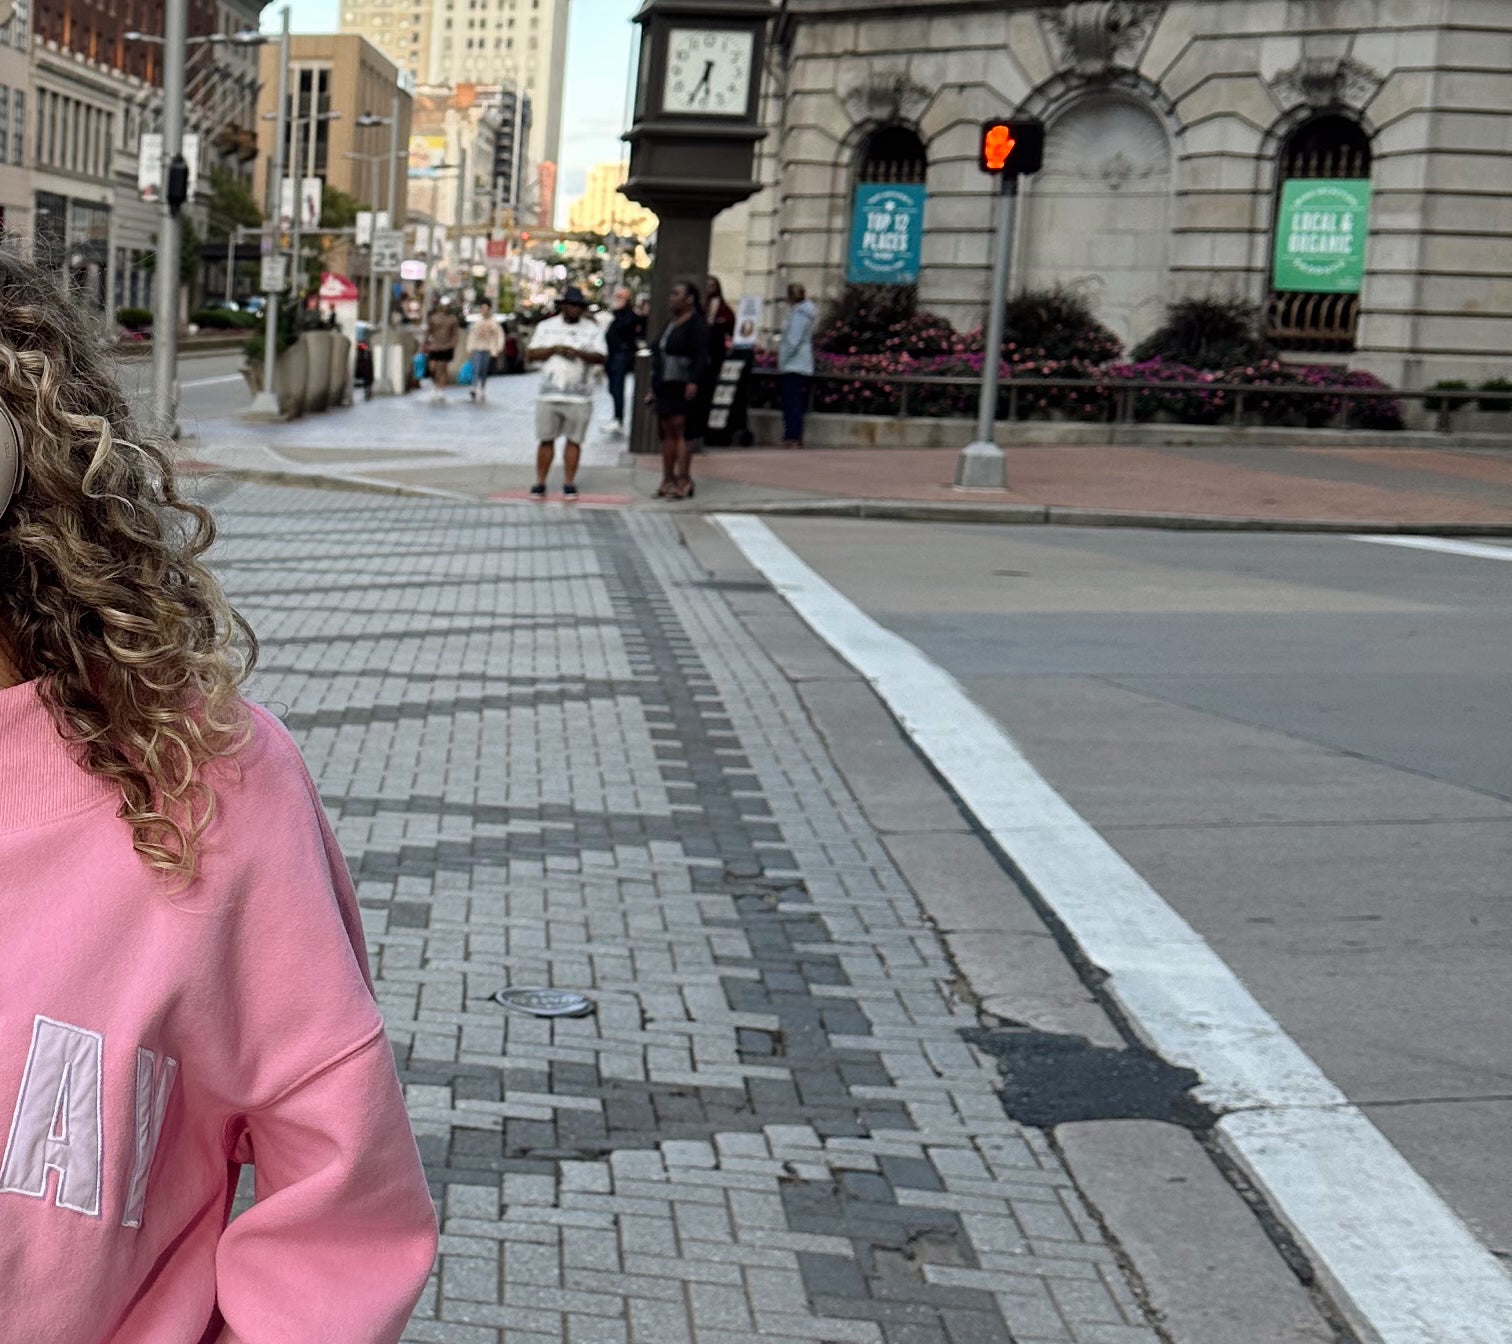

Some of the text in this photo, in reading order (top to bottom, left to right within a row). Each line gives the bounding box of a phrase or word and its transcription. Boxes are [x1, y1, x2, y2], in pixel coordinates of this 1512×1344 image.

[867, 212, 910, 232] TOP 12
[1291, 211, 1337, 232] LOCAL
[862, 232, 908, 252] PLACES
[1288, 233, 1353, 254] ORGANIC
